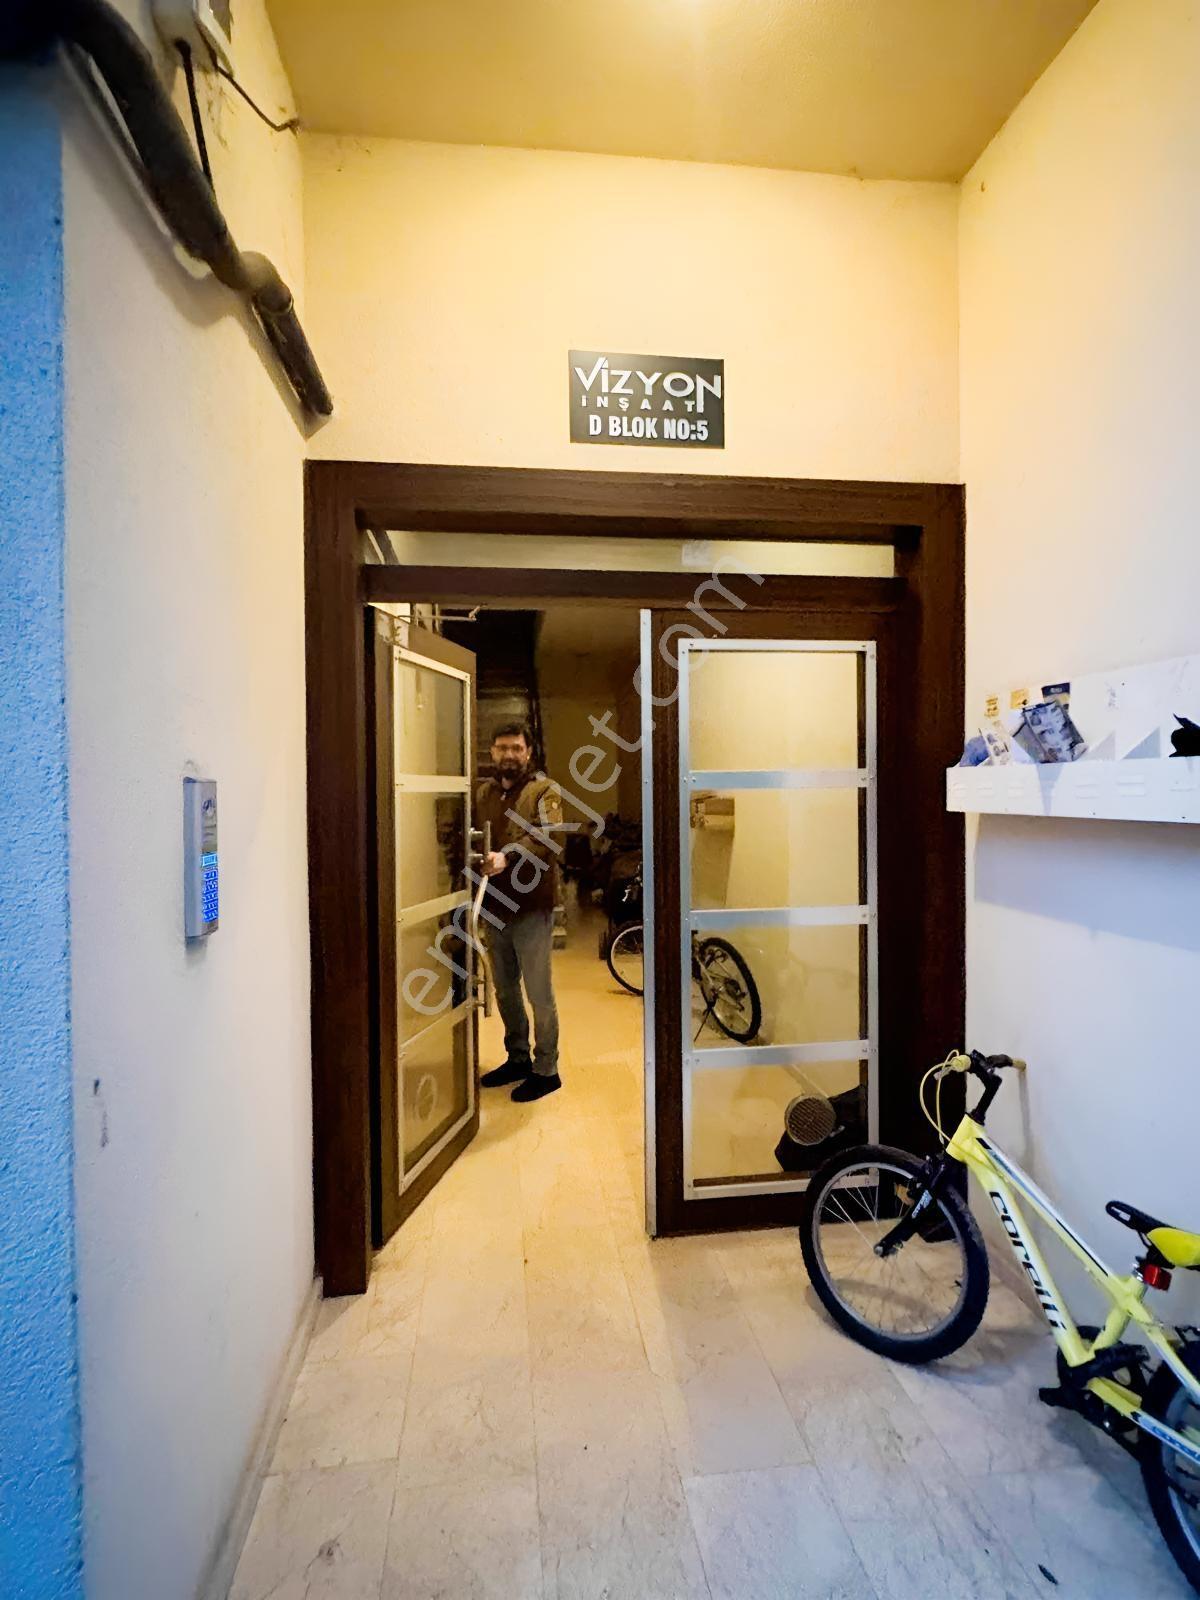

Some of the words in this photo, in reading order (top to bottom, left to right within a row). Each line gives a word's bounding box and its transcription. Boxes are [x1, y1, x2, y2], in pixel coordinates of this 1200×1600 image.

[589, 414, 602, 436] D
[608, 415, 658, 439] BLOK
[663, 418, 709, 441] NO:5
